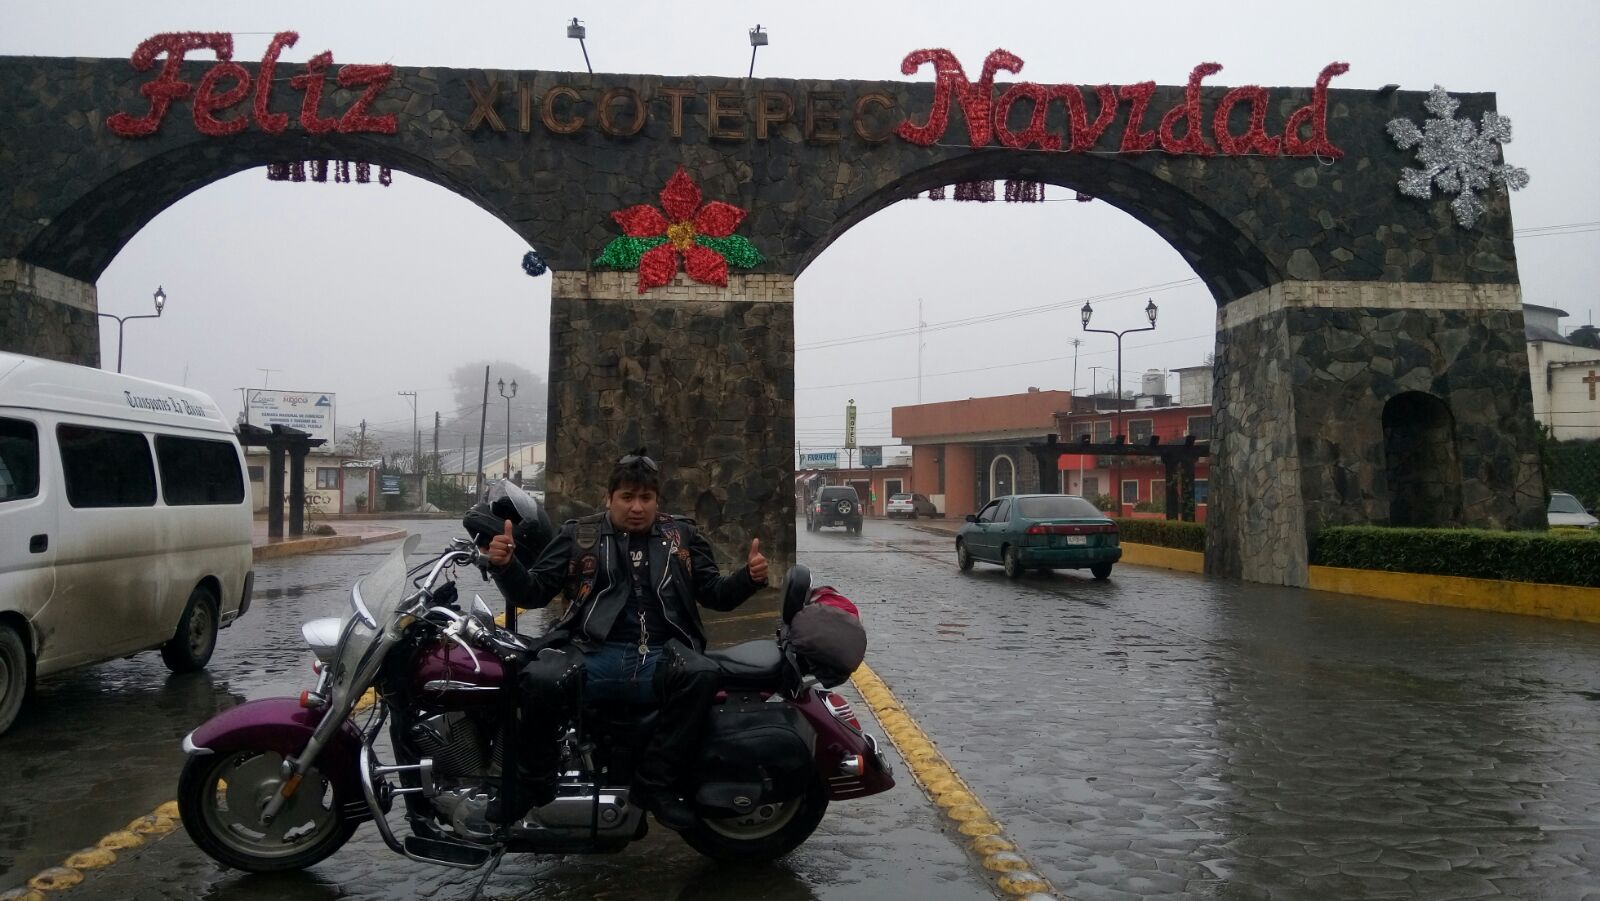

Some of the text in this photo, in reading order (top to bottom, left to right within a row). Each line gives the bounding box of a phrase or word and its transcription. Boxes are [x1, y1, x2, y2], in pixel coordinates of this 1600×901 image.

[107, 31, 398, 136] Feliz
[463, 79, 899, 142] XICOTEPEC
[896, 48, 1350, 158] Navidad
[124, 390, 171, 411] Transportes
